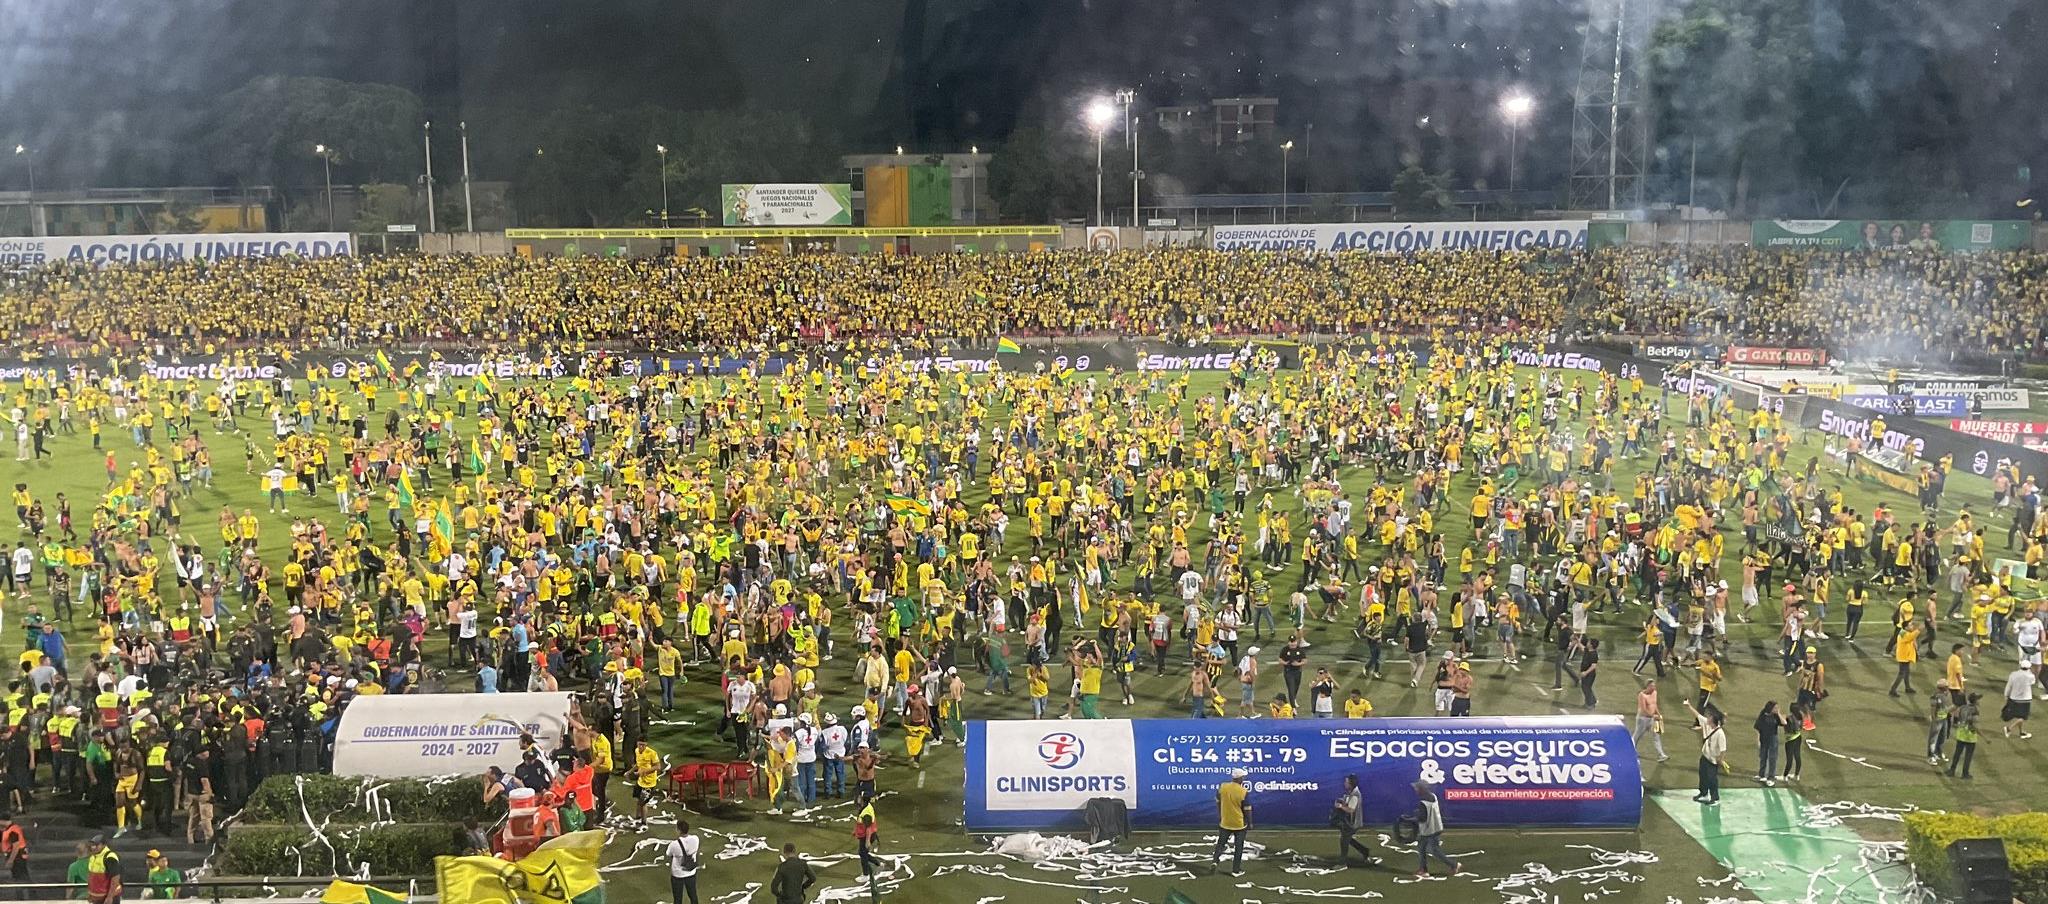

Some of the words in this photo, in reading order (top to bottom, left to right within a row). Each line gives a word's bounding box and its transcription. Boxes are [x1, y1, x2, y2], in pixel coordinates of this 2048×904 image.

[1215, 229, 1298, 240] GOBERNACIÓN
[1300, 230, 1316, 239] DE
[1330, 225, 1434, 253] ACCIÓN
[1441, 229, 1588, 251] UNIFICADA
[26, 242, 45, 251] DE
[66, 237, 184, 266] ACCIÓN
[194, 240, 350, 262] UNIFICADA
[1216, 240, 1316, 253] SANTANDER
[1647, 346, 1691, 358] BetPlay
[1751, 351, 1818, 362] GATRAD
[0, 367, 39, 379] BetPy
[1959, 420, 2020, 433] MUEBLES
[2023, 423, 2033, 434] &
[363, 723, 449, 738] GOBERNACIÓN
[451, 725, 467, 736] DE
[469, 724, 541, 736] SANTANER
[1167, 735, 1201, 745] (+57)
[1204, 735, 1226, 744] 317
[1230, 735, 1289, 744] 5003250
[421, 744, 455, 756] 2024
[467, 743, 500, 755] 2027
[1153, 748, 1183, 763] Cl.
[1190, 748, 1219, 763] 54
[1225, 748, 1271, 763] #31-
[1278, 748, 1307, 763] 79
[1329, 736, 1471, 764] Espacios
[1477, 740, 1606, 763] seguros
[1419, 759, 1446, 784] &
[1453, 755, 1612, 784] efectivos
[996, 775, 1126, 792] CLINISPORTS
[1254, 780, 1318, 793] @clinisports
[1447, 790, 1469, 799] para
[1483, 789, 1539, 798] tratamiento
[1548, 789, 1612, 799] recuperación.
